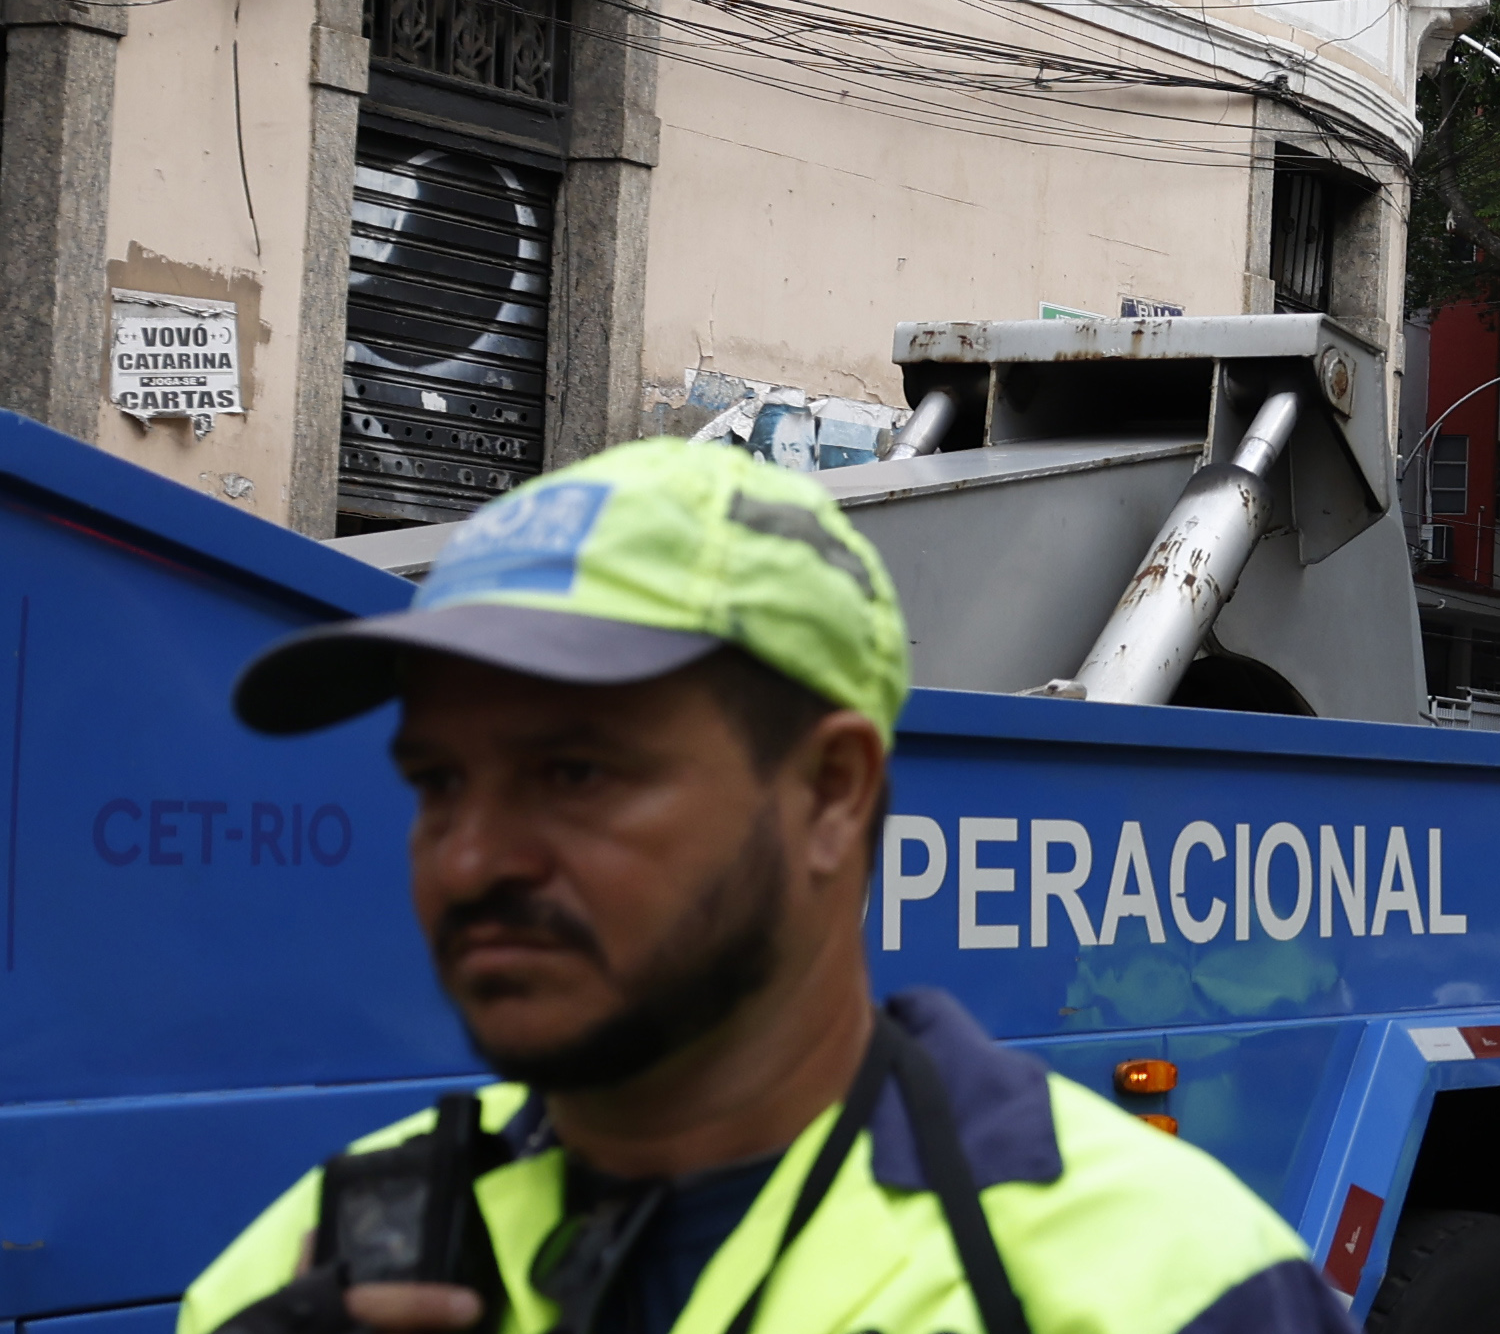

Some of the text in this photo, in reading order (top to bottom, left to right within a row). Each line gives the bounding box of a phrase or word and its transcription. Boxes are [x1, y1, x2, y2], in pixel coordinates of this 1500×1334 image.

[140, 323, 208, 348] VOVÓ
[117, 352, 233, 371] CATARINA
[119, 389, 235, 410] CARTAS
[92, 797, 353, 868] CET-RIO
[864, 813, 1468, 952] PERACIONAL
